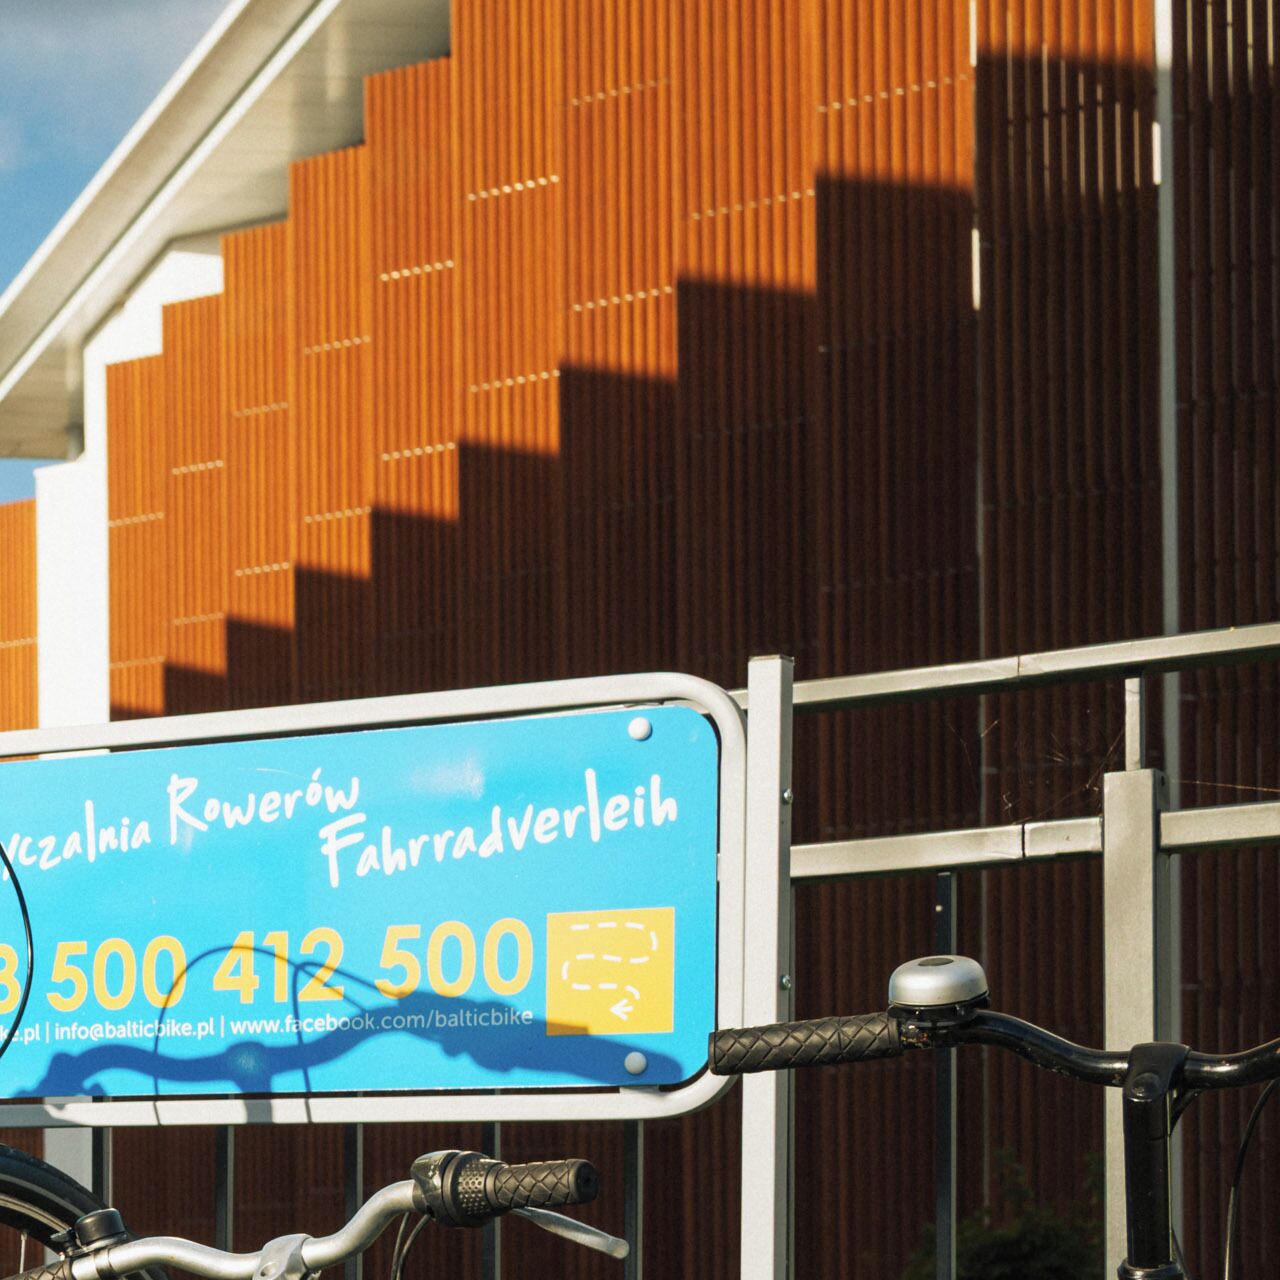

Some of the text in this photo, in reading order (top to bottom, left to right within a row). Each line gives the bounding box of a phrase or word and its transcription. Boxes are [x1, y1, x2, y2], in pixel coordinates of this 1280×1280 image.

[167, 768, 359, 846] Rowerów
[318, 768, 678, 888] Fahrradverleih
[46, 935, 188, 1013] 500
[212, 927, 345, 1005] 412
[374, 917, 534, 1000] 500
[54, 1017, 215, 1042] info@balticbike.pl
[230, 1007, 534, 1036] www.facebook.com/balticbike
